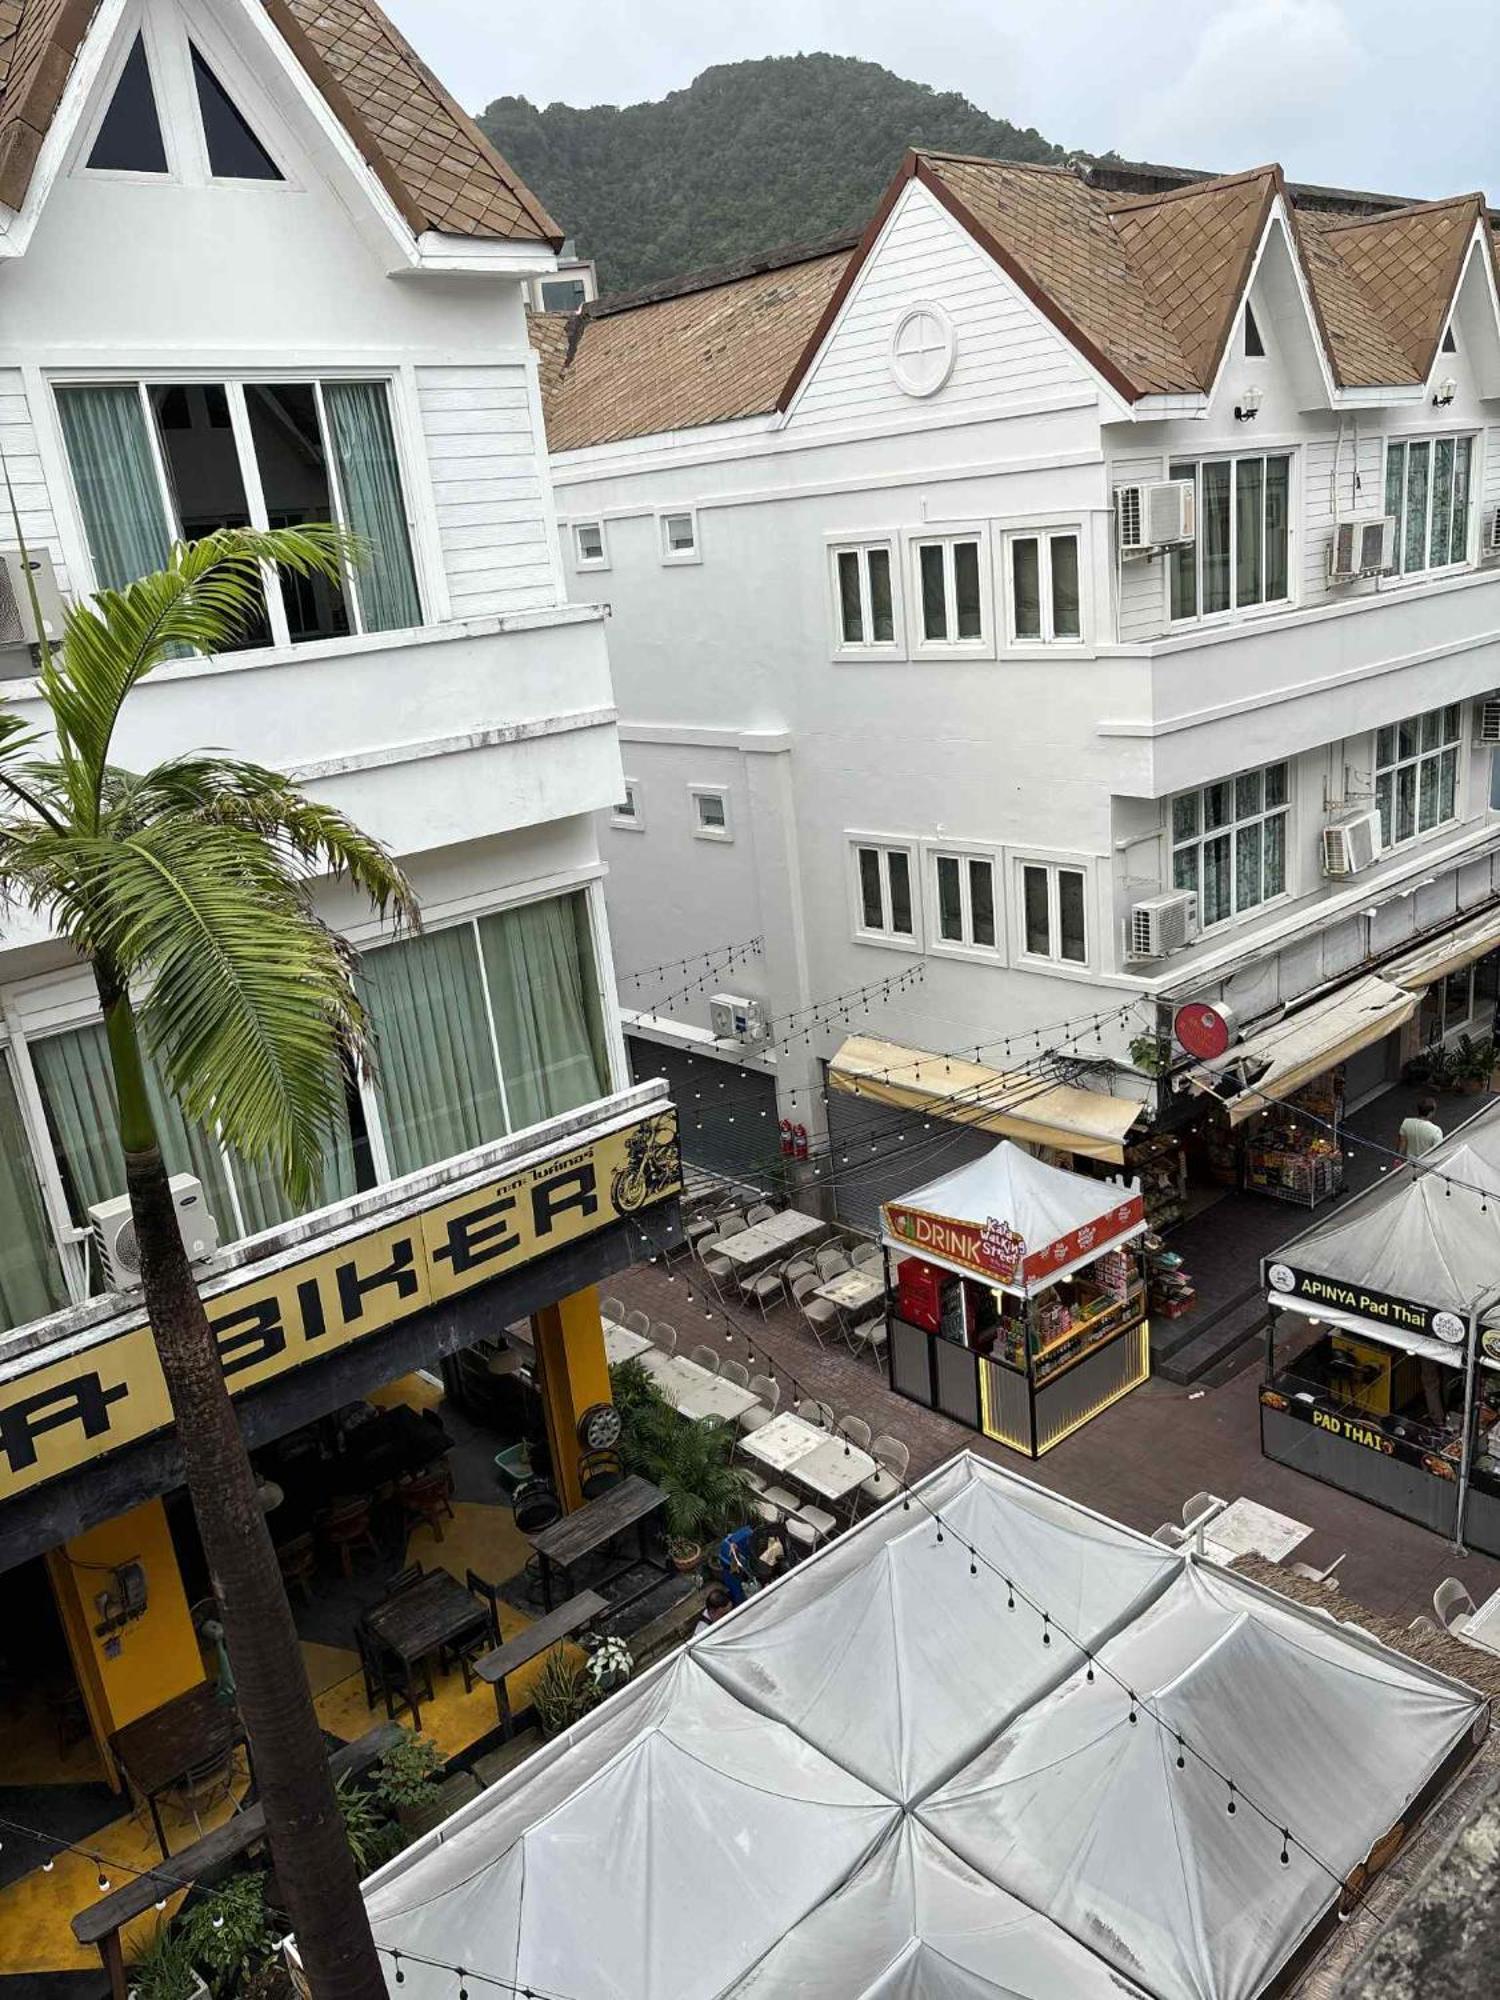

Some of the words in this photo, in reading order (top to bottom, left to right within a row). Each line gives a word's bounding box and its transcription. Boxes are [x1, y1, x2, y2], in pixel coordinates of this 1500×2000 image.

[915, 1217, 981, 1264] DRINK
[987, 1217, 1013, 1240] Kata
[206, 1164, 598, 1372] BIKER
[1301, 1279, 1356, 1306] APINYA
[1360, 1296, 1389, 1318] Pad
[1392, 1304, 1425, 1328] Thai
[1313, 1410, 1341, 1433] PAD
[1343, 1423, 1383, 1451] THAI
